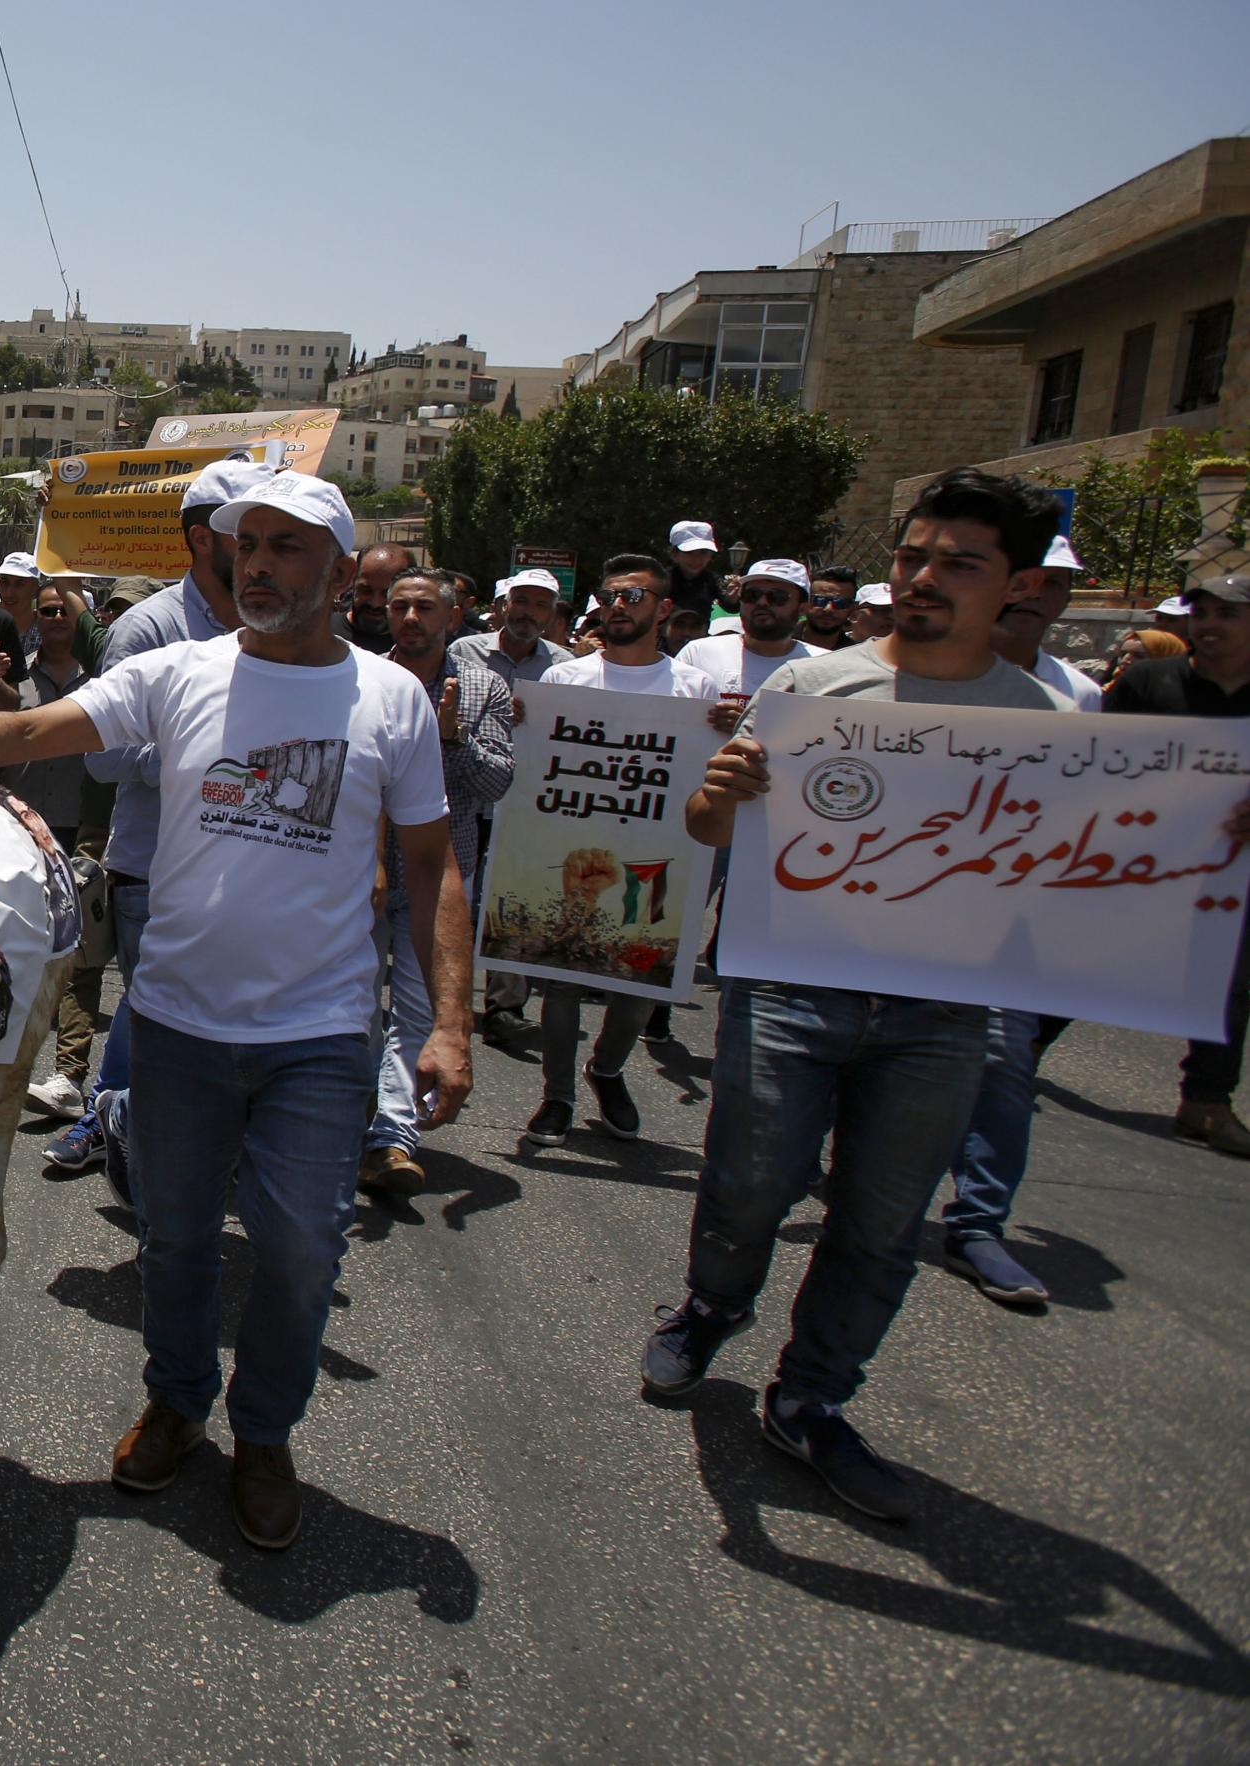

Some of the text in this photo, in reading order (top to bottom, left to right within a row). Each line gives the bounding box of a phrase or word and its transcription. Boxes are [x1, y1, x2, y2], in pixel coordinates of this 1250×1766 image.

[187, 413, 332, 438] معكم وبكم سيادة الرئيس
[118, 460, 194, 476] Down The
[75, 481, 192, 495] deal off the cen
[52, 508, 181, 520] Our conflict with Israel is
[100, 525, 183, 537] it's political con
[128, 543, 163, 554] الاحتلال
[165, 545, 178, 554] مع
[108, 559, 132, 569] صراع
[135, 559, 162, 570] وليس
[549, 715, 676, 763] يسقط
[788, 716, 1250, 779] فقة القرن لن تمر مهما كلفنا الأمر
[543, 754, 670, 791] مؤتمر
[203, 781, 221, 789] RUN
[202, 788, 245, 804] FREEDOM
[536, 787, 666, 824] البحرين
[200, 810, 229, 824] القرن
[229, 812, 258, 827] صفقة
[259, 819, 280, 832] ضد
[223, 828, 243, 837] united
[242, 832, 263, 842] against
[263, 835, 274, 844] the
[274, 838, 287, 847] deal
[288, 840, 295, 848] of
[306, 844, 329, 856] Century
[774, 773, 1241, 912] يسقط مؤتمر البحرين
